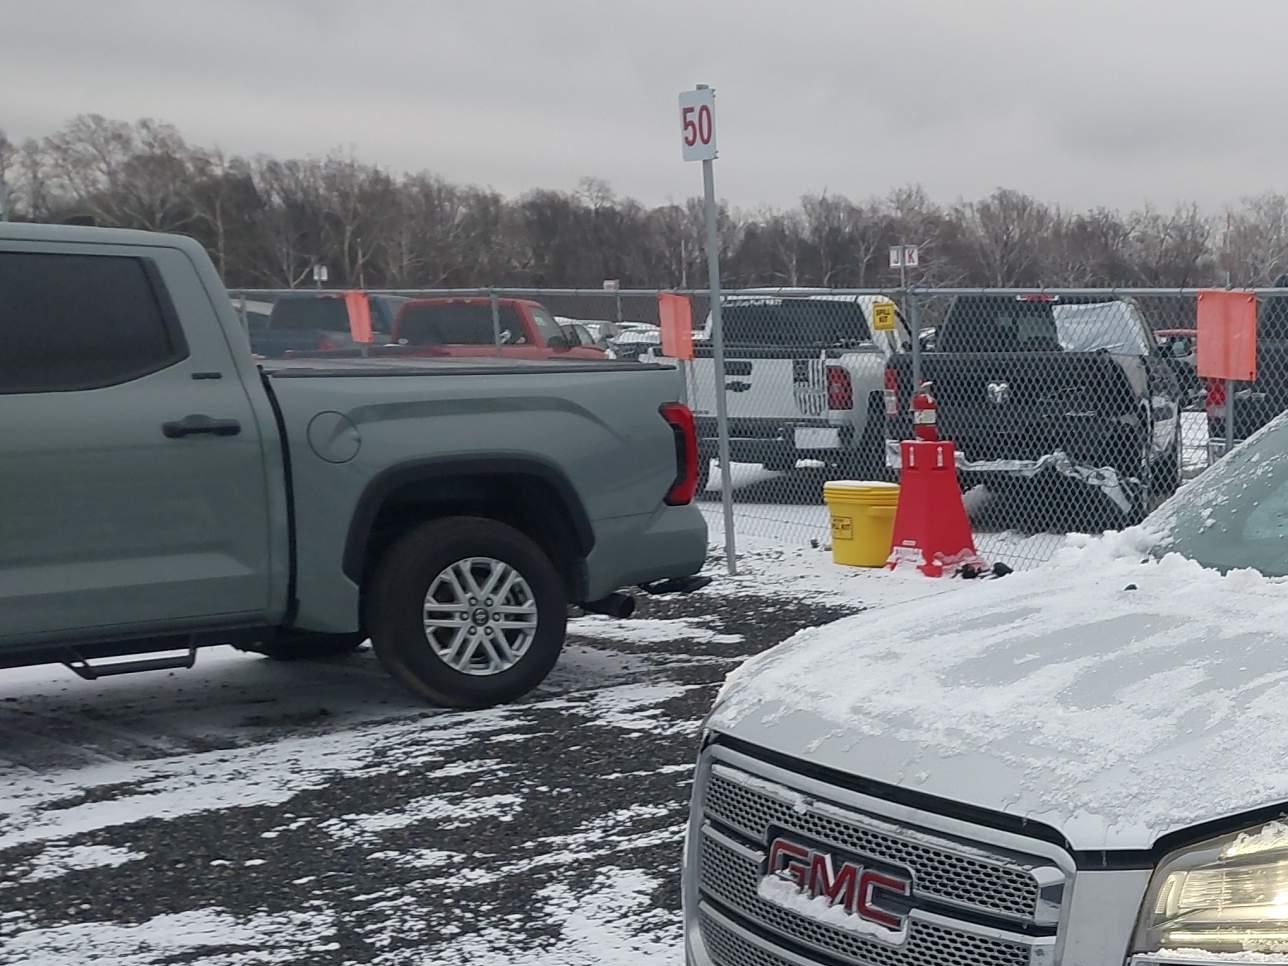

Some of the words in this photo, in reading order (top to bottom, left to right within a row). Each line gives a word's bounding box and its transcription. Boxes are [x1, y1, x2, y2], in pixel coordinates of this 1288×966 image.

[682, 105, 712, 147] 50
[907, 249, 915, 263] K
[768, 837, 912, 930] GMC
